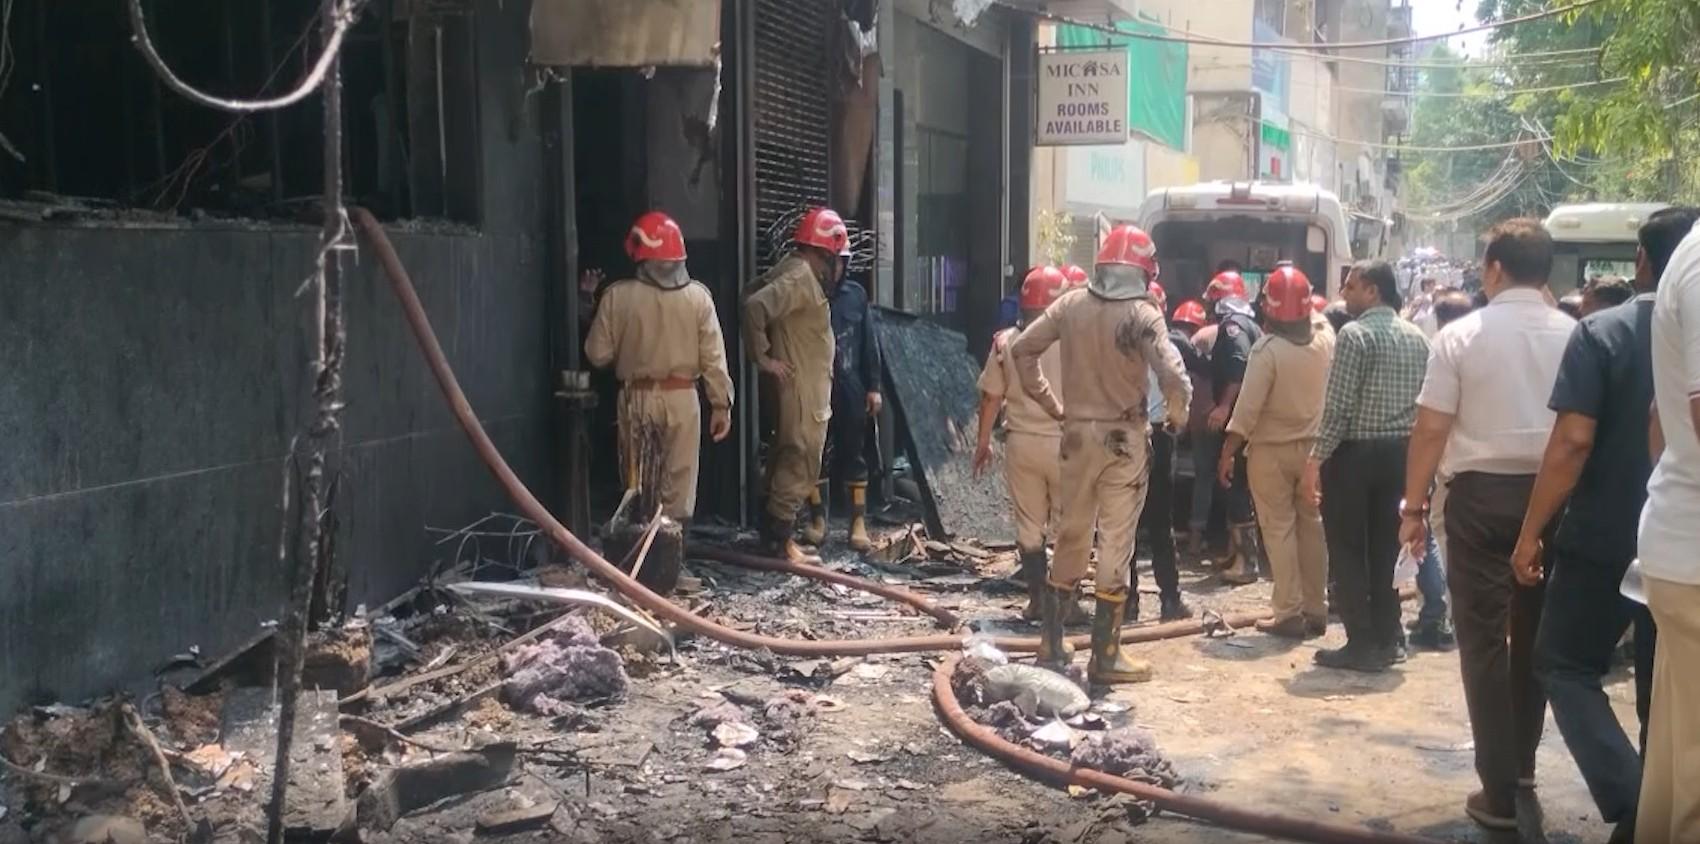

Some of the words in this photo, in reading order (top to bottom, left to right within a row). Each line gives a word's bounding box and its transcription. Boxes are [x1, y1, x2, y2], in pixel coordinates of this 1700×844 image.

[1068, 82, 1099, 97] INN
[1057, 102, 1109, 117] ROOMS
[1046, 119, 1121, 135] AVAILABLE
